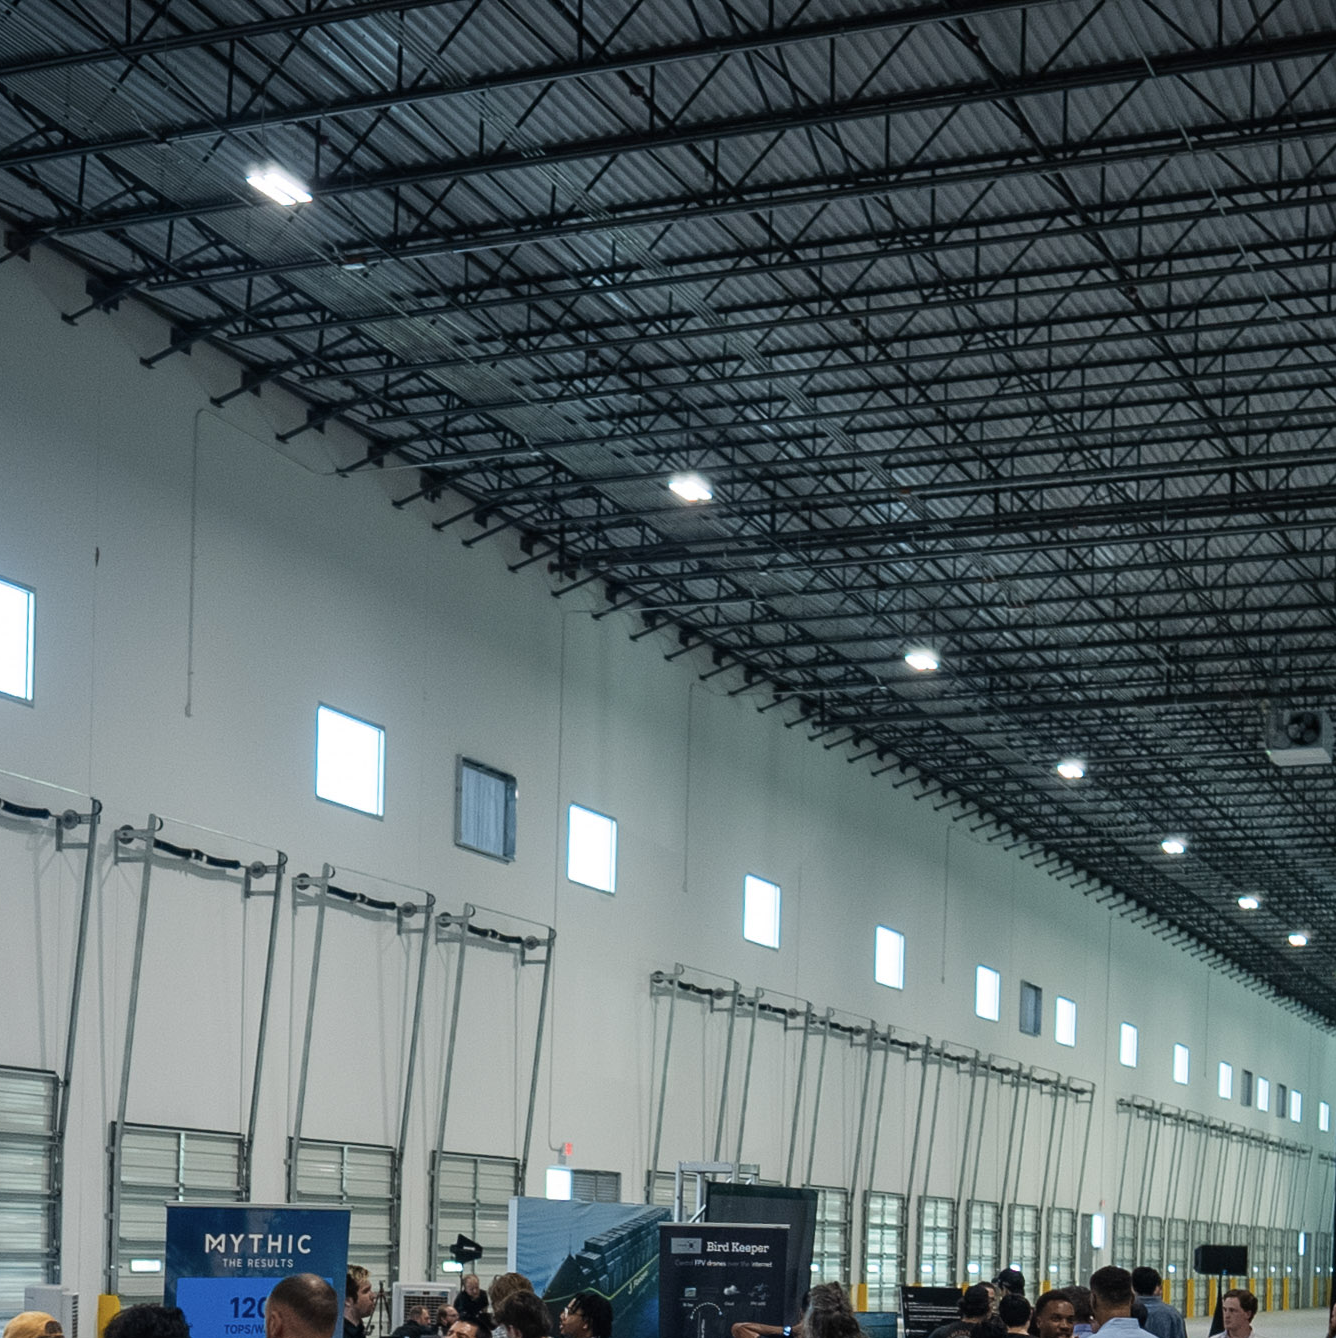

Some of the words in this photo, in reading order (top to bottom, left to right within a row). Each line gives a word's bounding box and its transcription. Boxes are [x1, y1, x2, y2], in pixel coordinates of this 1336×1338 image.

[204, 1233, 312, 1255] MYTHIC
[706, 1241, 730, 1253] Bird
[731, 1242, 770, 1256] Keeper
[222, 1258, 243, 1268] THE
[247, 1258, 294, 1269] RESULTS
[706, 1259, 727, 1267] drones
[224, 1323, 266, 1336] TOPS/W
